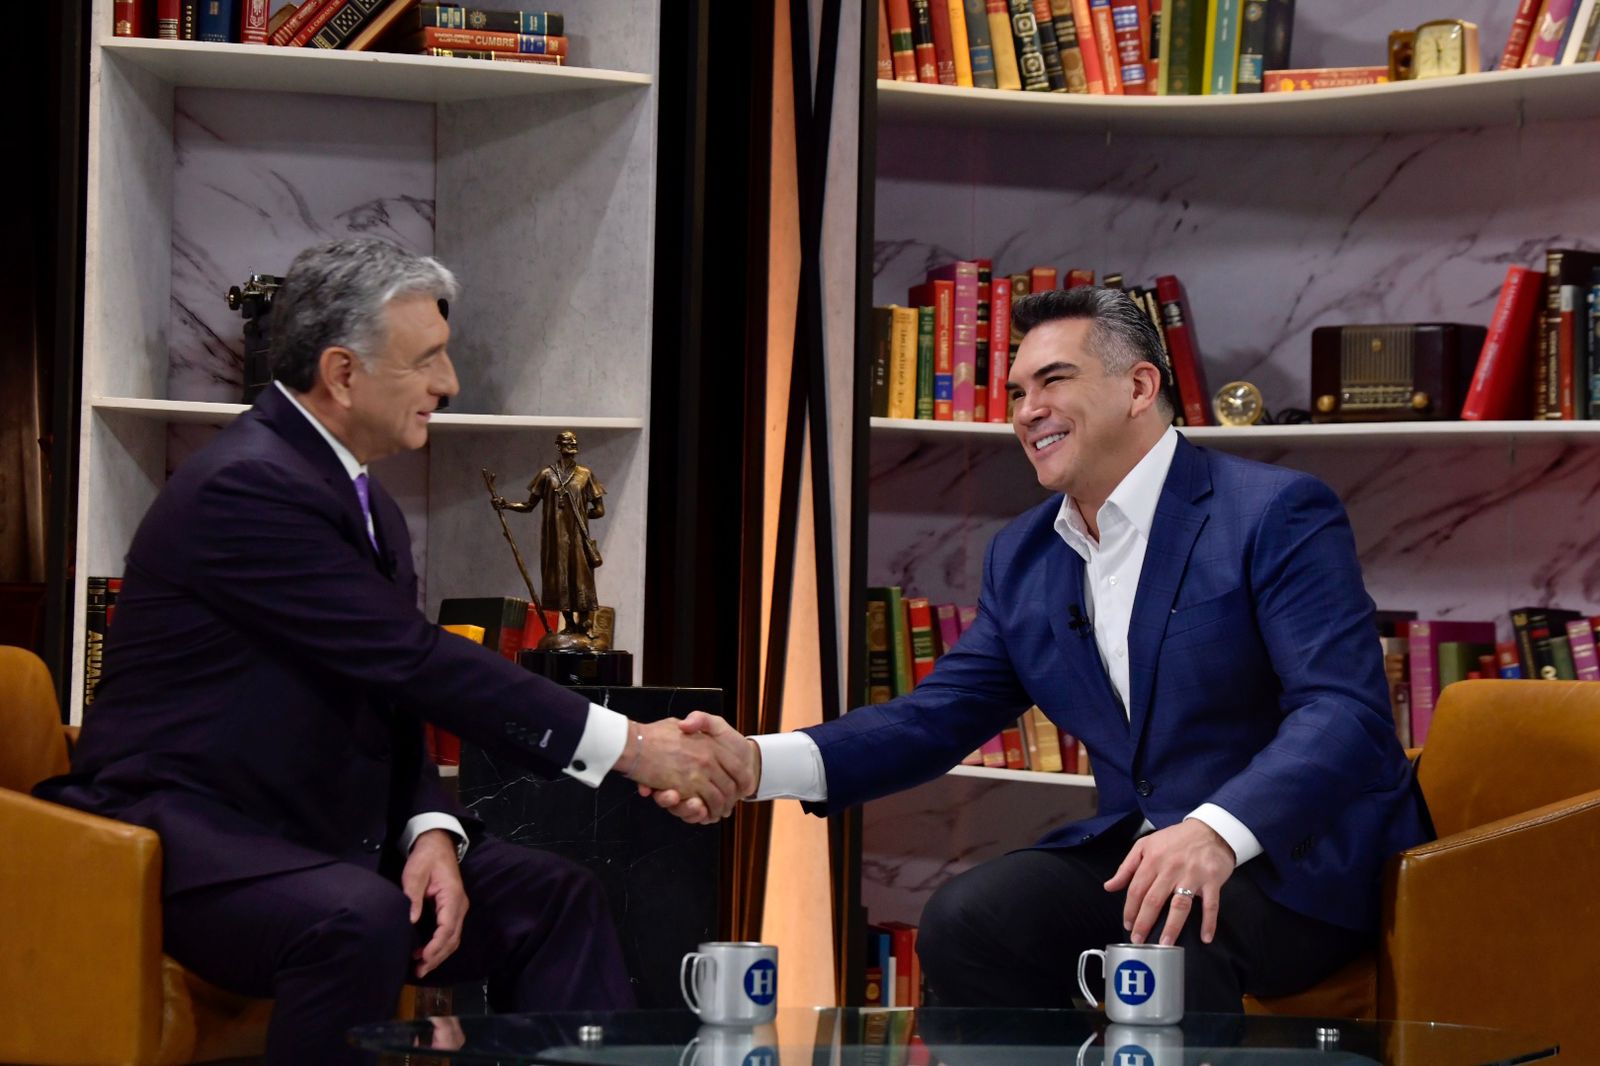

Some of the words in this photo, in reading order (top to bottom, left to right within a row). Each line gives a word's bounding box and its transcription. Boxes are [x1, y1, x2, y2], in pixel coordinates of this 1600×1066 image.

[475, 35, 515, 47] CUMBRE
[751, 969, 774, 996] H
[1119, 969, 1147, 996] H
